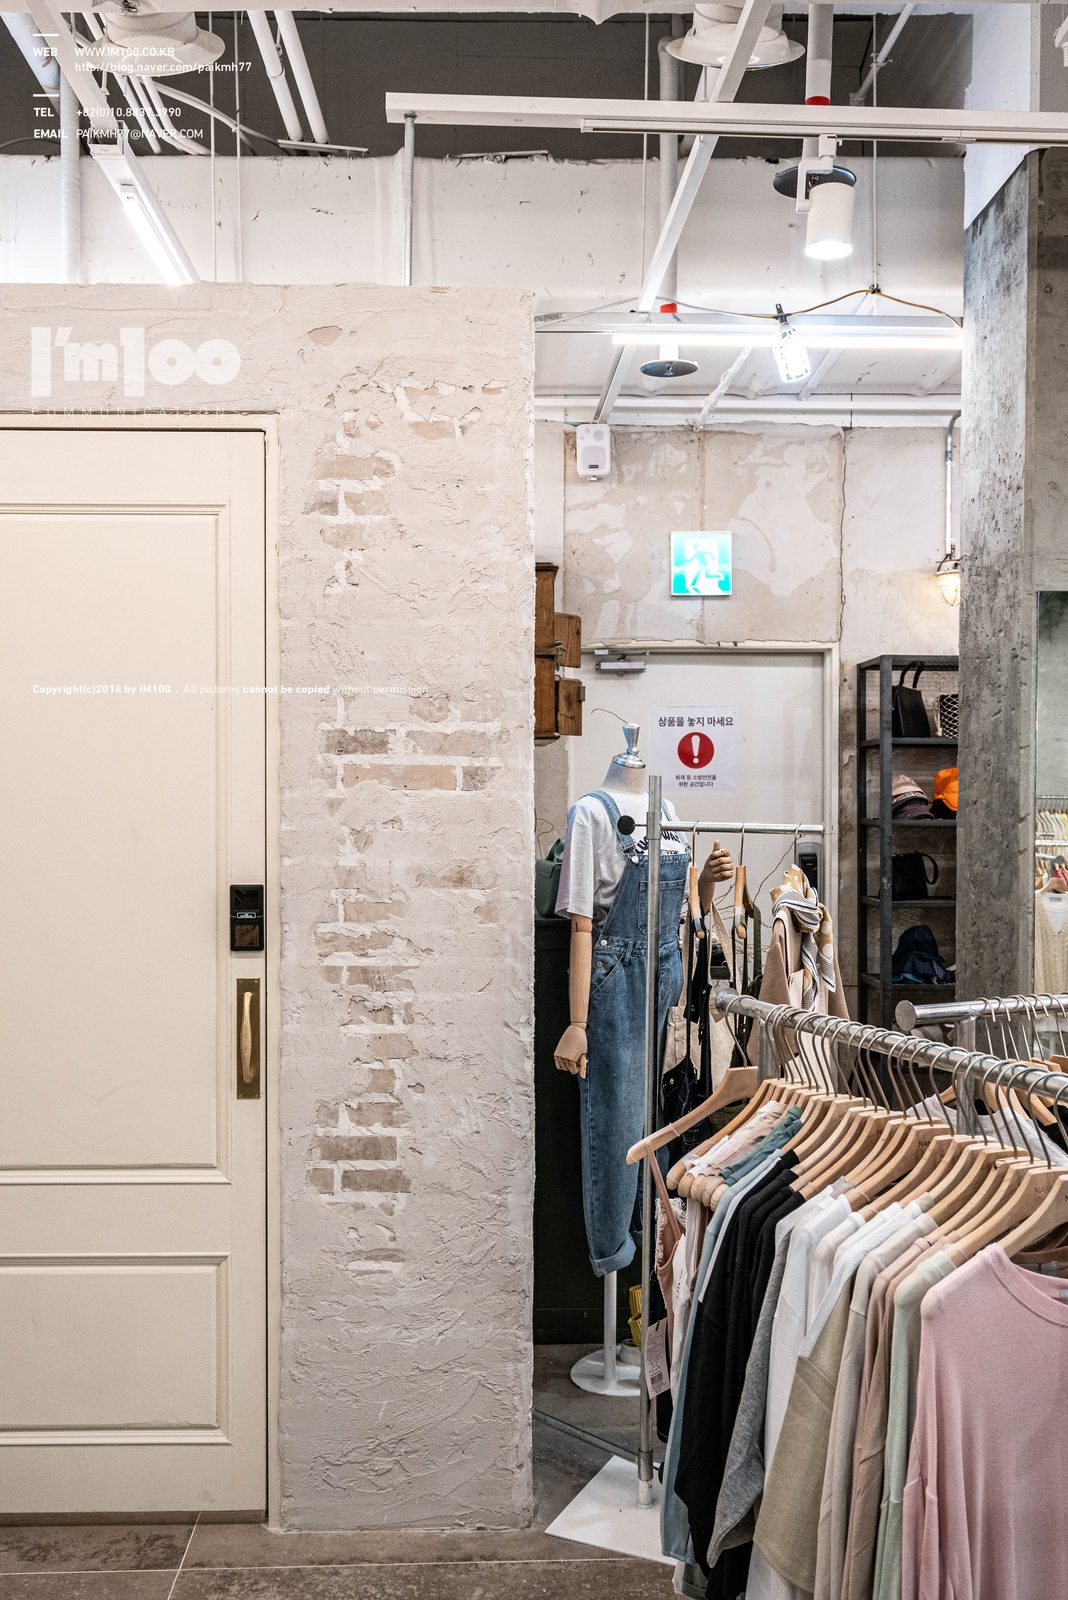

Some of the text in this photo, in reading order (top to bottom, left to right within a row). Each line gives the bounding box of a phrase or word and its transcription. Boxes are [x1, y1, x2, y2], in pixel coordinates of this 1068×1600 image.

[658, 716, 734, 727] 상품을 놓지 마세요
